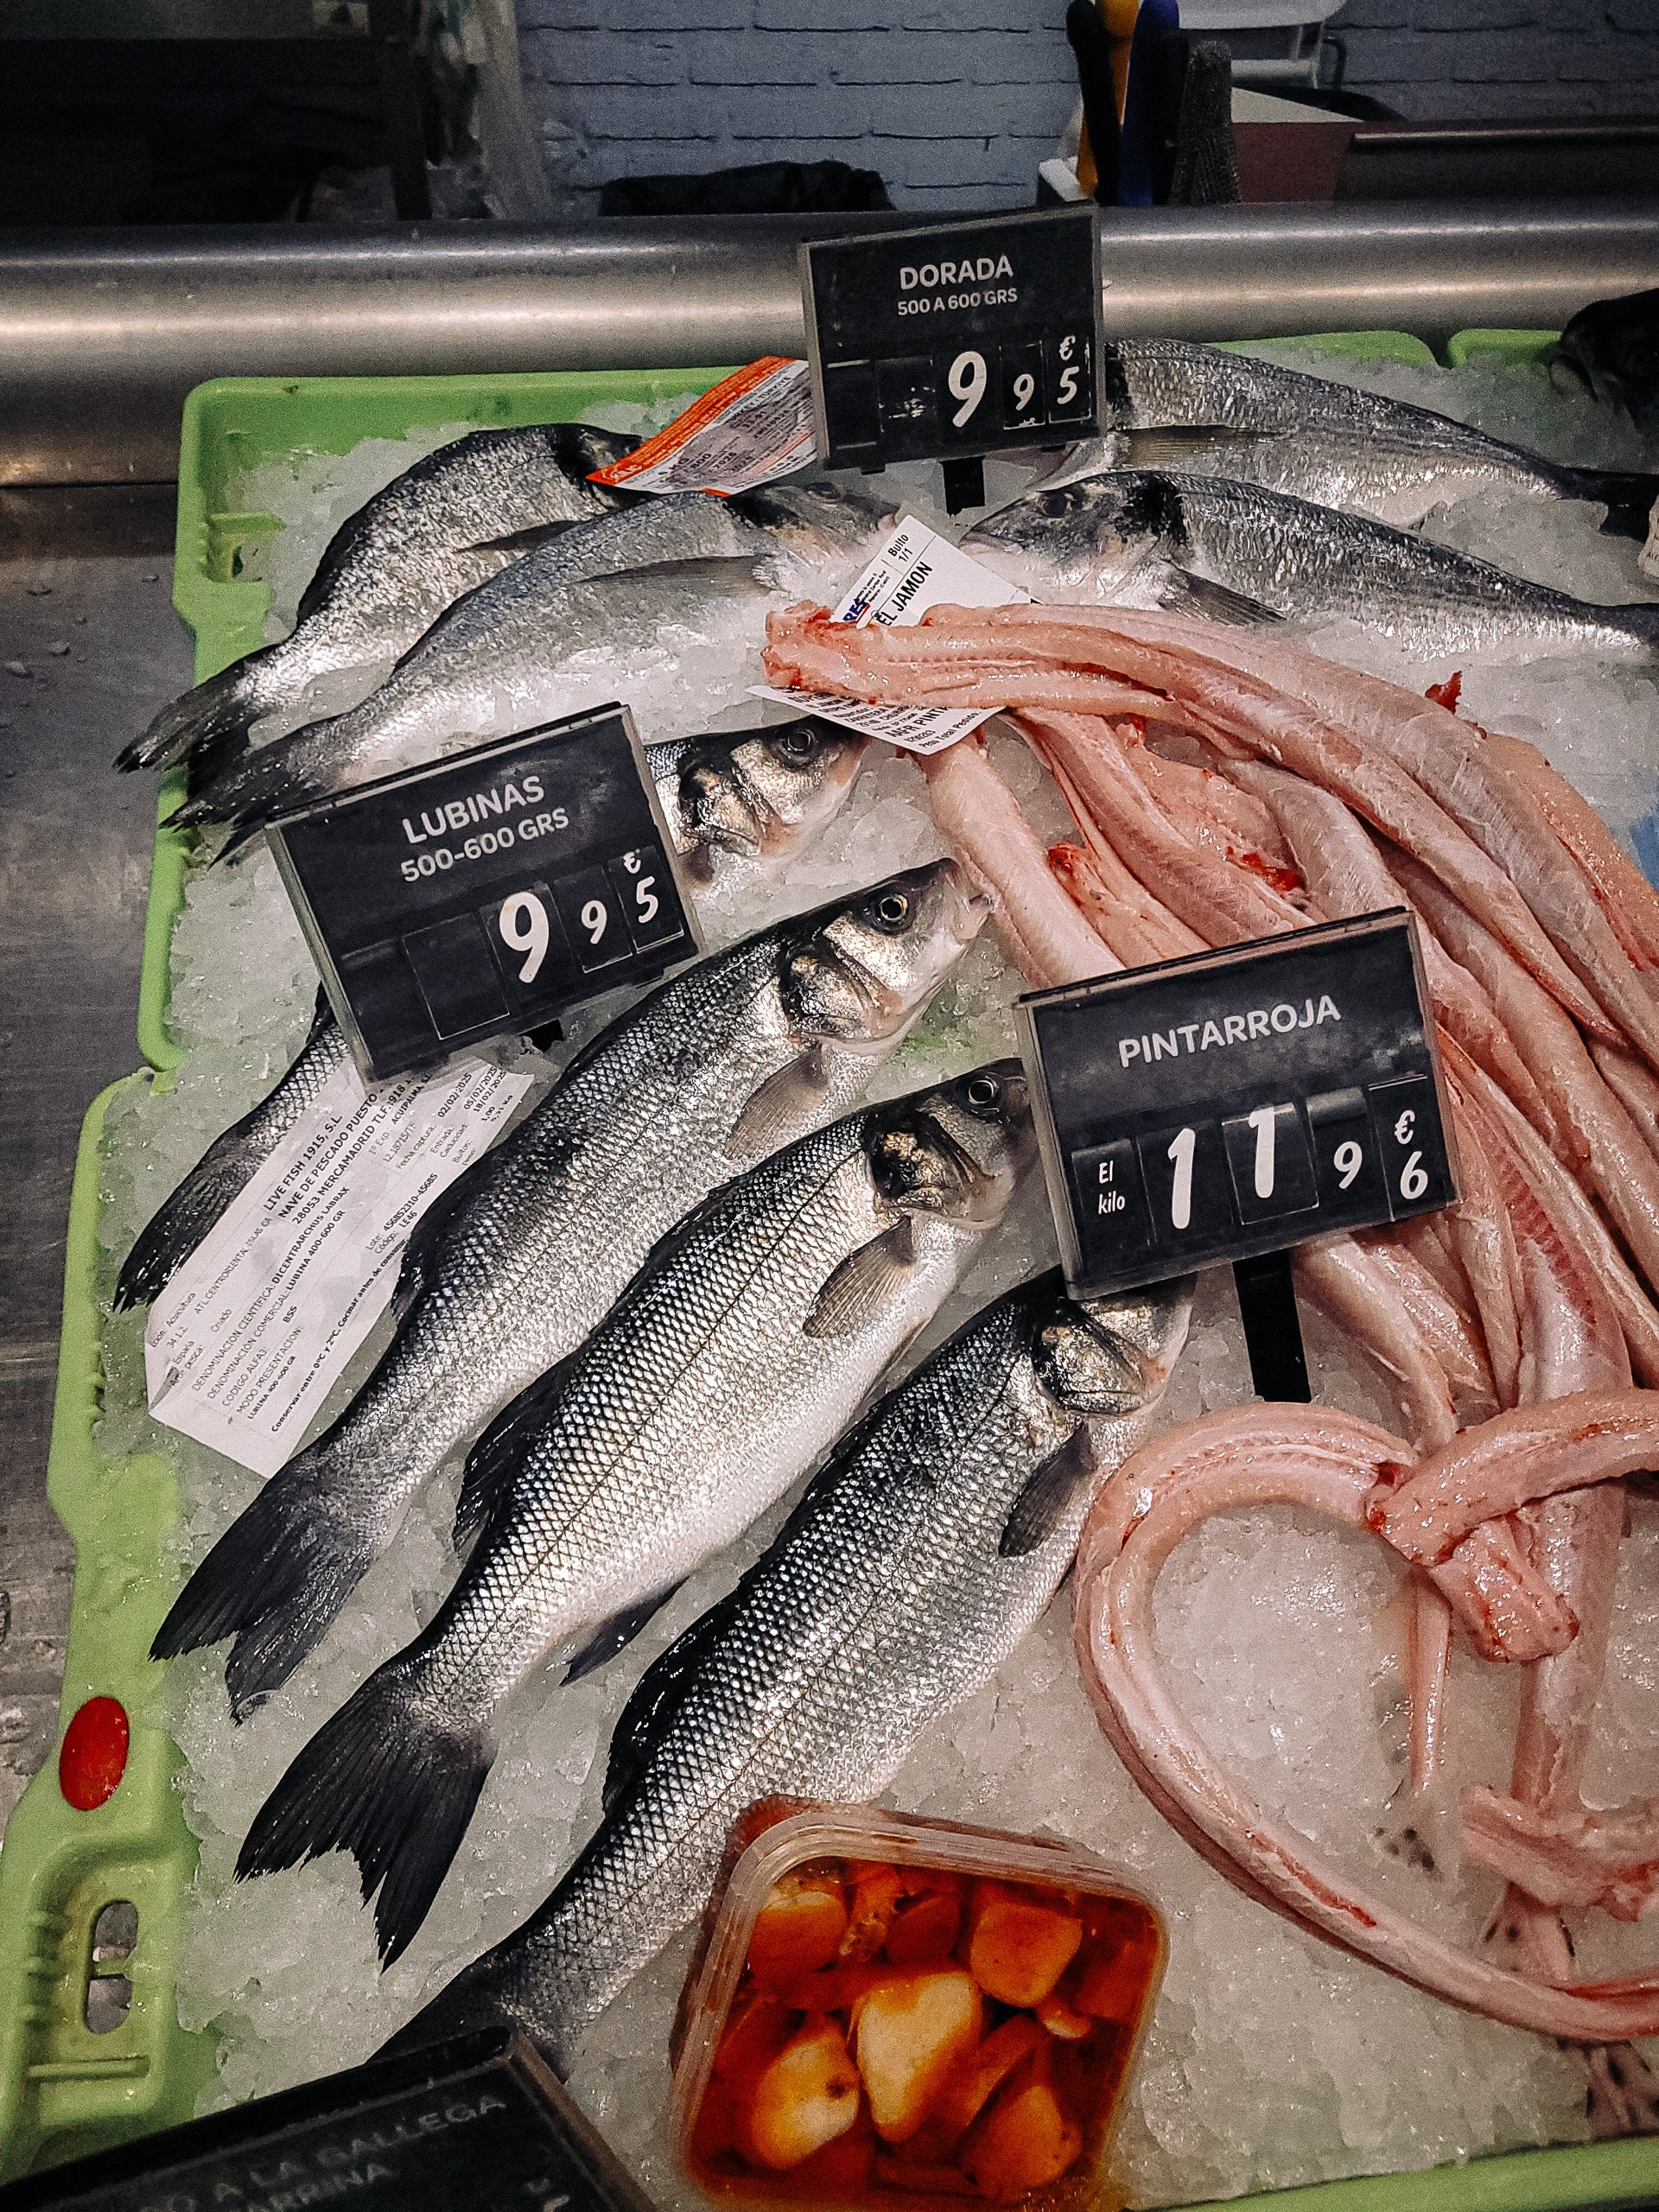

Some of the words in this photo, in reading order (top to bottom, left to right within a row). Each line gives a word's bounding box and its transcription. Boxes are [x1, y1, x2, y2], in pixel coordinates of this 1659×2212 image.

[898, 298, 931, 315] 500
[933, 295, 945, 311] A
[948, 292, 980, 310] 600
[984, 288, 1018, 304] GRS
[899, 254, 1014, 290] DORADA
[948, 351, 987, 428] 9
[887, 533, 909, 557] Bulto
[898, 546, 913, 563] 1/1
[891, 560, 932, 612] JAMON
[400, 826, 516, 882] 500-600
[518, 807, 569, 842] GRS
[401, 776, 545, 844] LUBINAS
[499, 892, 550, 983] 9
[1118, 995, 1341, 1068] PINTARROJA
[462, 1065, 498, 1109] 05/02/2025
[472, 1067, 507, 1112] 18/02/2025
[263, 1184, 287, 1211] LIVE
[281, 1160, 306, 1186] FISH
[302, 1133, 329, 1161] 1915,
[276, 1191, 304, 1218] NAVE
[298, 1175, 315, 1192] DE
[310, 1131, 349, 1178] PESCADO
[345, 1090, 378, 1132] PUESTO
[290, 1195, 321, 1224] 28053
[316, 1124, 375, 1196] MERCAMADRID
[1098, 1160, 1114, 1185] El
[270, 1215, 324, 1284] DICENTRARCHUS
[320, 1185, 350, 1214] LABRAX
[284, 1257, 311, 1291] LUBINA
[307, 1221, 335, 1256] 400-600
[332, 1209, 346, 1222] GR
[270, 1392, 302, 1432] Conservar
[299, 1370, 315, 1392] entre
[336, 1296, 359, 1327] Cocinar
[357, 1277, 375, 1298] antes
[372, 1267, 382, 1277] de
[235, 1388, 258, 1413] MODO
